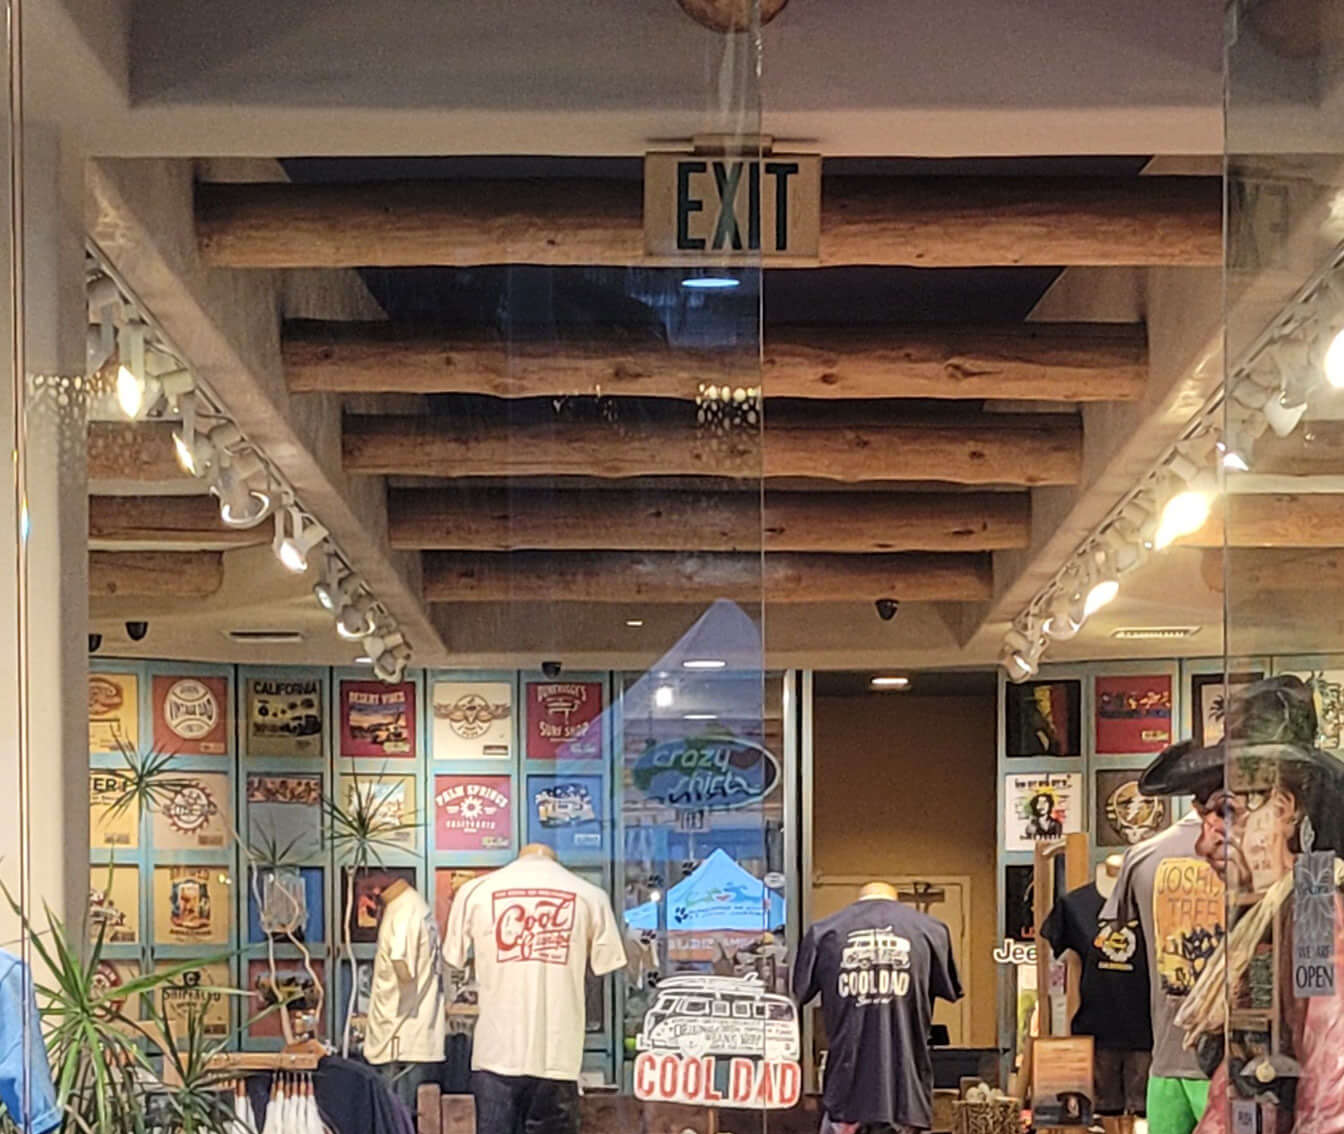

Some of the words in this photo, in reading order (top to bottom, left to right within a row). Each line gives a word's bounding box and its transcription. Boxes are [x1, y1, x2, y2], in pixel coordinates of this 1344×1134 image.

[677, 161, 799, 251] EXIT
[255, 680, 317, 696] CALIFORNIA
[653, 749, 731, 772] crazy
[1167, 898, 1218, 921] TREE
[993, 938, 1038, 964] Jee
[838, 969, 878, 998] COOL
[878, 969, 911, 997] DAD
[1295, 965, 1334, 988] OPEN
[636, 1054, 722, 1101] COOL
[732, 1059, 798, 1105] DAD
